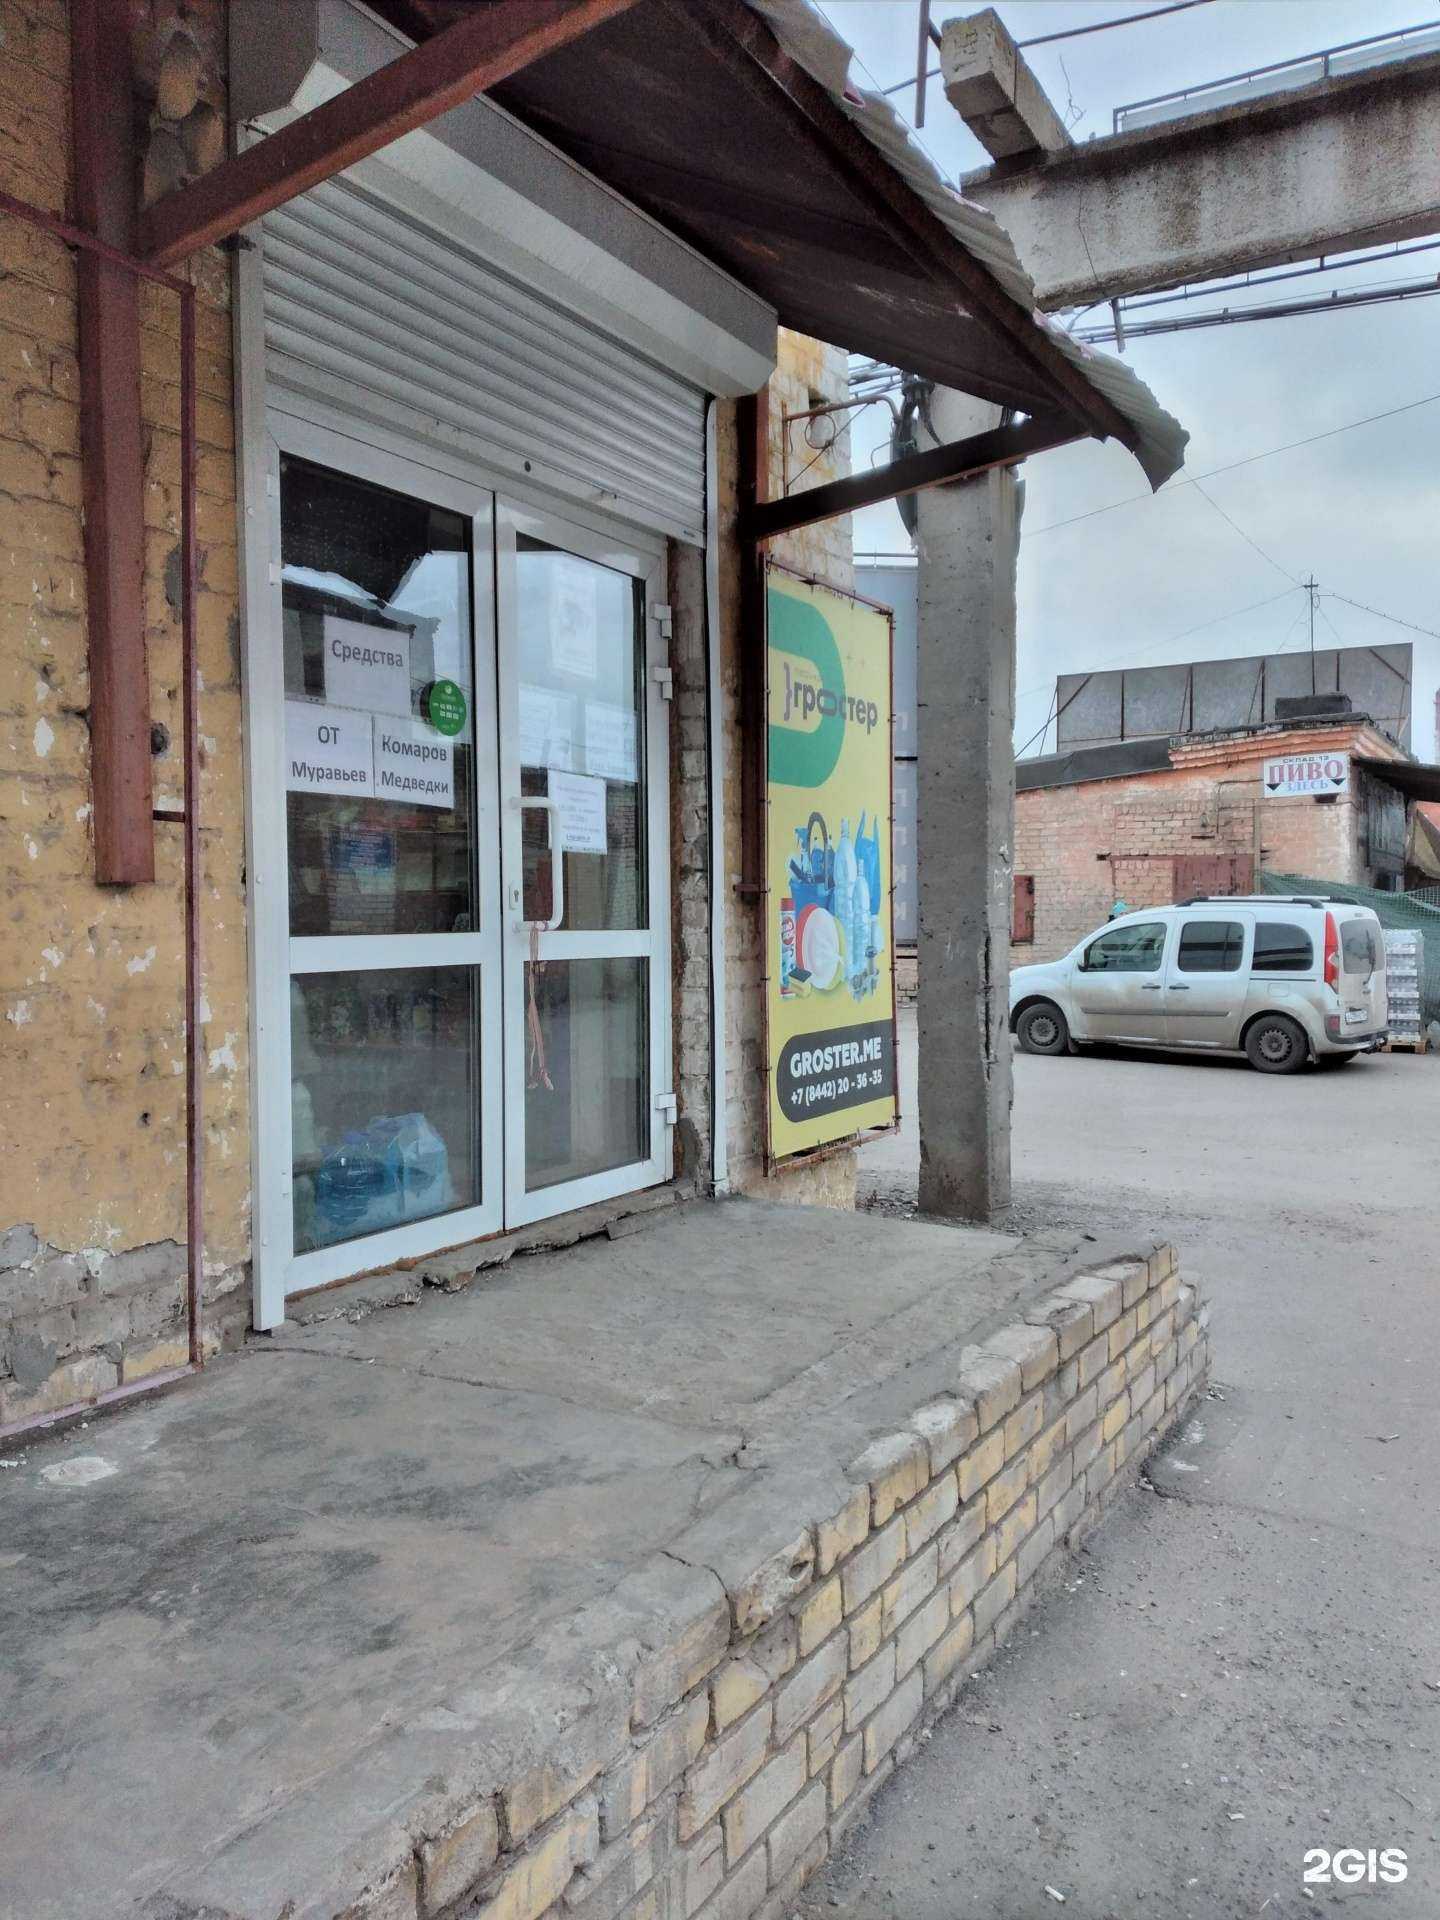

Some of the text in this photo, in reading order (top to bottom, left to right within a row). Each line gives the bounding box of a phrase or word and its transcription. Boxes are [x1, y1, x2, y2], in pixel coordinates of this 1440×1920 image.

[332, 640, 403, 667] Средства
[382, 734, 448, 762] Комаров
[291, 761, 367, 783] Муравьев
[381, 771, 449, 795] Медведки
[1269, 760, 1344, 784] ПИВО
[1286, 780, 1329, 792] ЗДЕСЬ
[790, 1037, 882, 1078] GROSTER.ME
[791, 1087, 803, 1105] +7
[805, 1080, 836, 1106] (8442)
